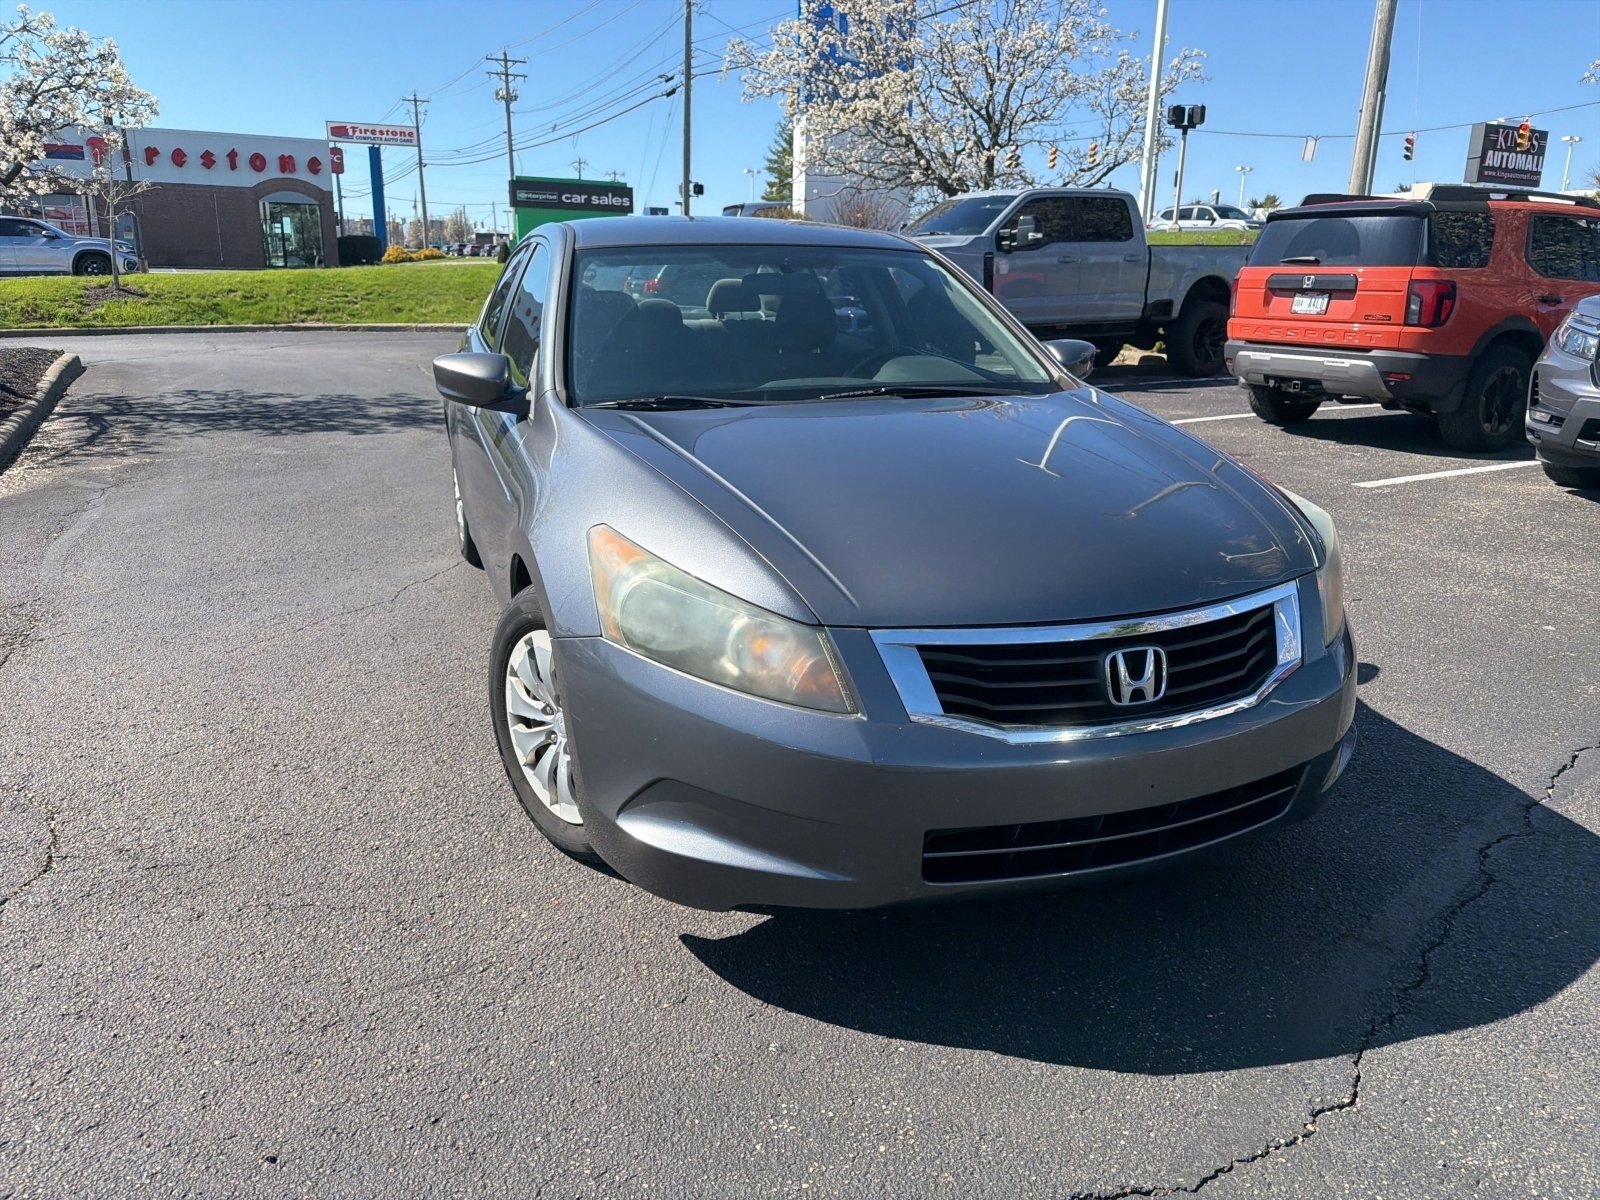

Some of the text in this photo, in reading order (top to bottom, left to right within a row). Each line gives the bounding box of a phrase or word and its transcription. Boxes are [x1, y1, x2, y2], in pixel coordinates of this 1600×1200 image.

[349, 125, 414, 138] Firestone
[1496, 129, 1540, 153] KINS
[86, 136, 322, 175] Frestone
[1485, 150, 1543, 171] AUTOMALL
[518, 192, 630, 206] enterprise car sales
[1240, 326, 1383, 344] PASSPORT
